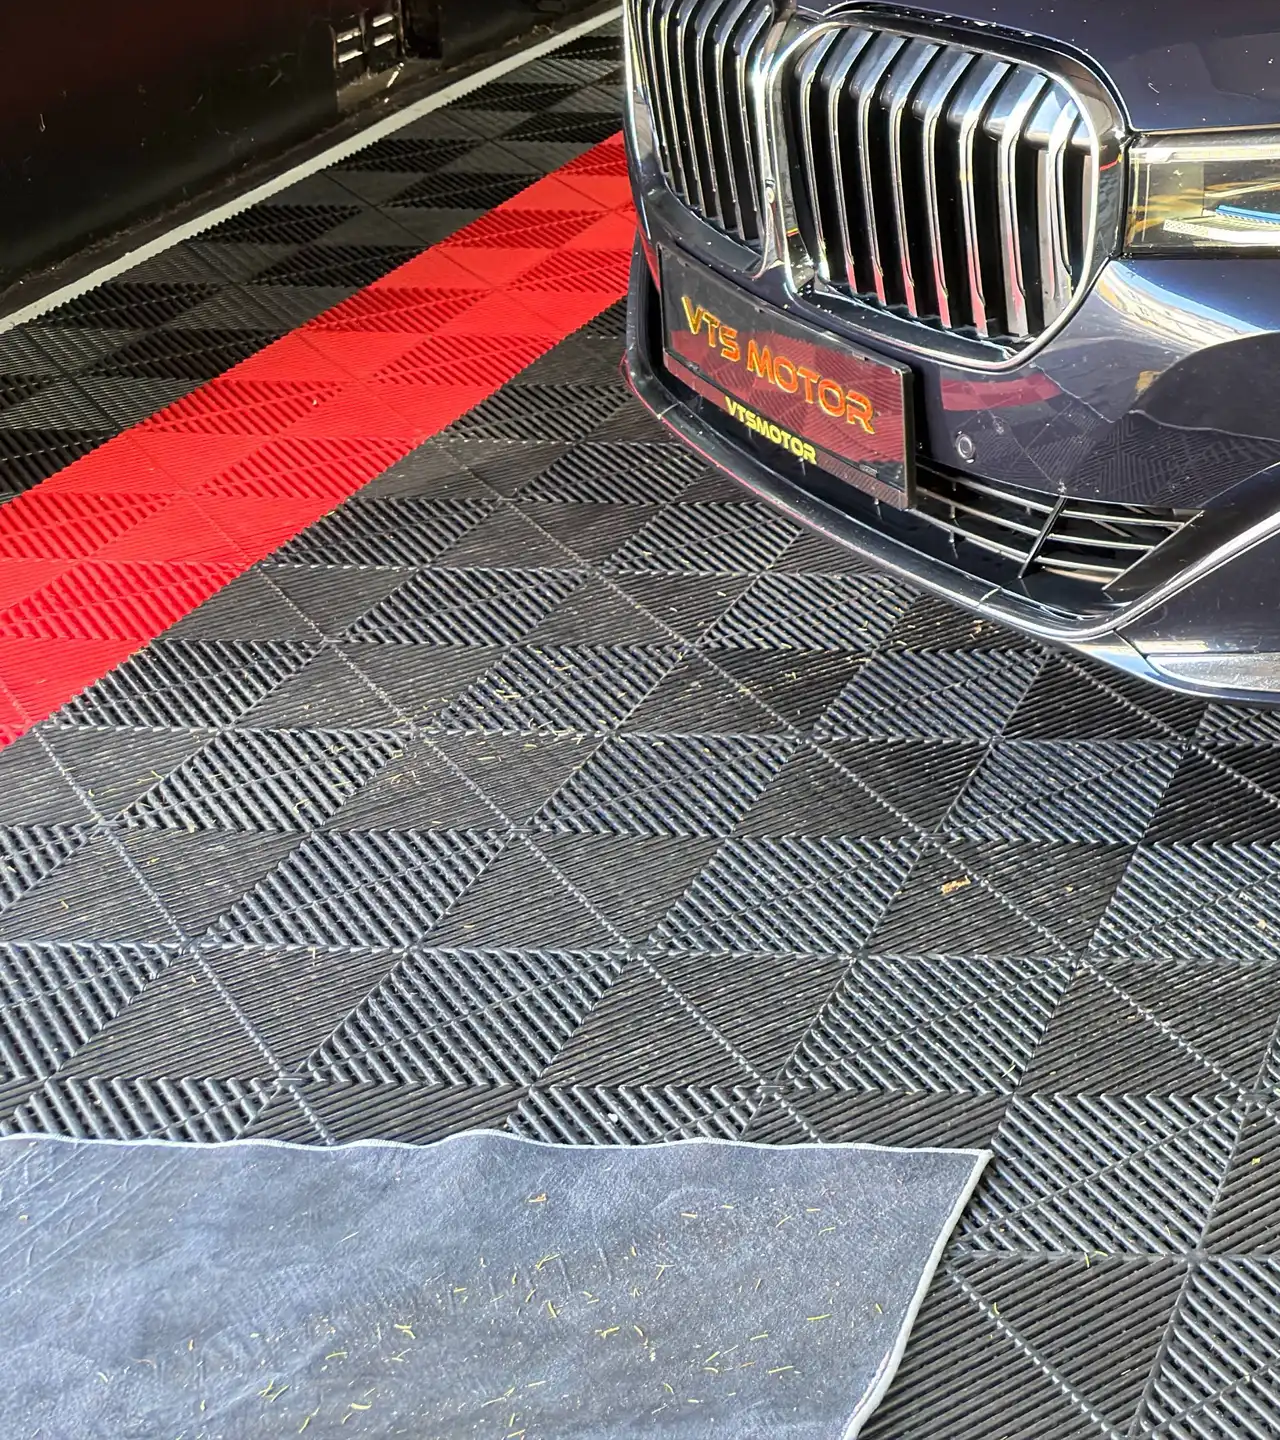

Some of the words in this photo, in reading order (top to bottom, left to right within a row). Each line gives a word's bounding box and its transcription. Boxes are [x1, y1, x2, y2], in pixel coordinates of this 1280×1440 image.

[681, 296, 741, 362] VTS
[747, 339, 875, 435] MOTOR
[725, 396, 817, 465] VTSMOTOR
